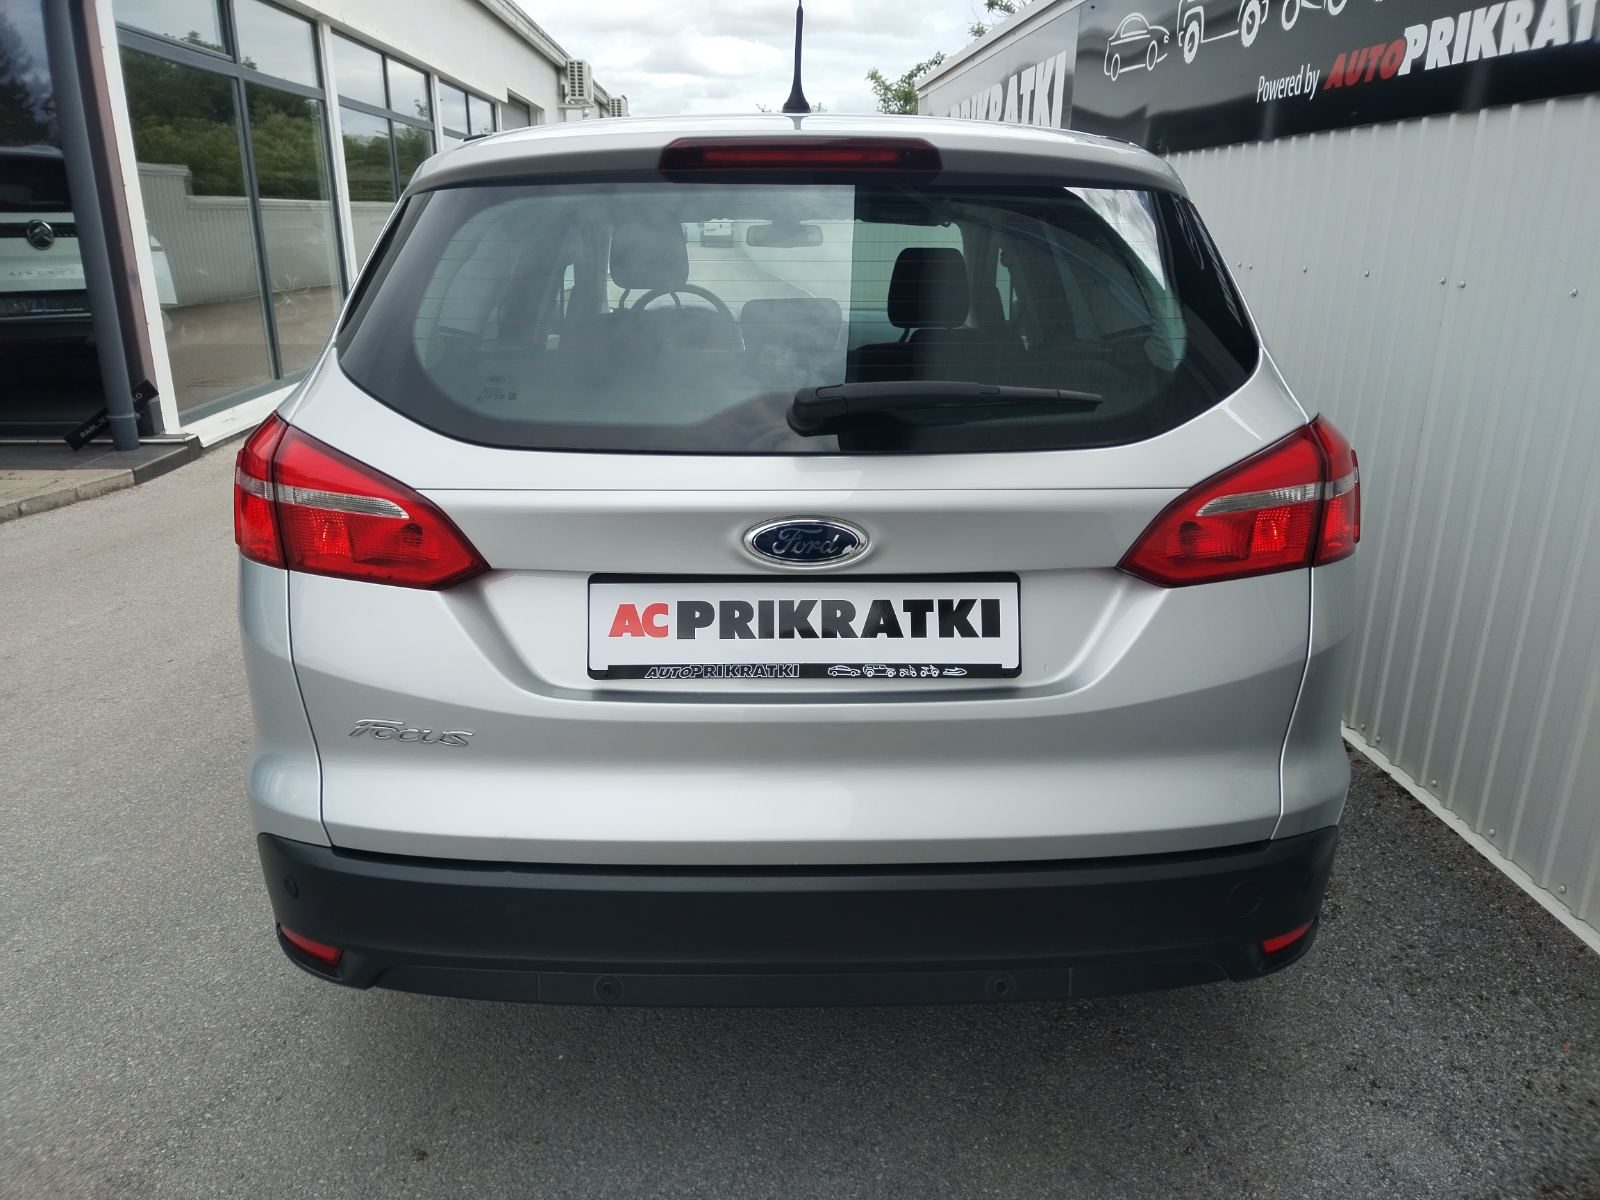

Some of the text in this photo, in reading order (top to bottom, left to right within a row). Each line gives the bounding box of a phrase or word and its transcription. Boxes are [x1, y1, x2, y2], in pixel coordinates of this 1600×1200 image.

[1256, 65, 1304, 103] Powered
[1304, 63, 1321, 101] by
[771, 527, 841, 557] Ford
